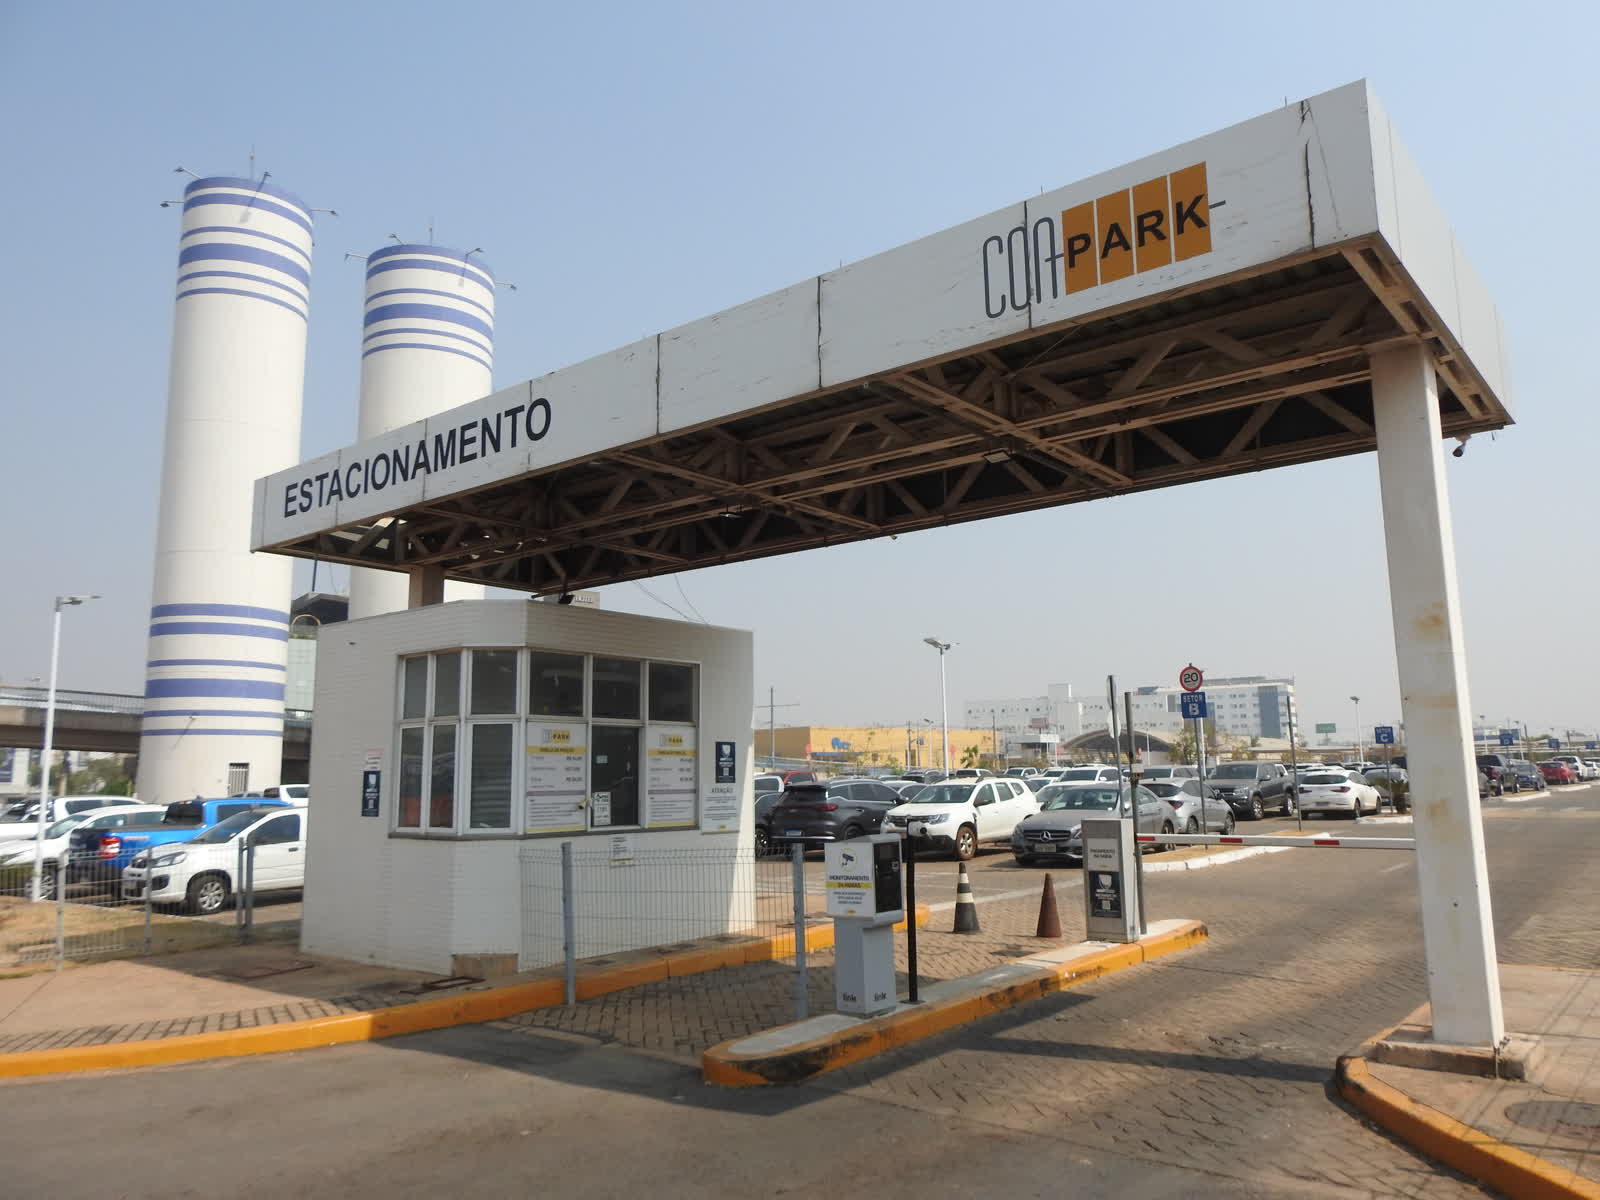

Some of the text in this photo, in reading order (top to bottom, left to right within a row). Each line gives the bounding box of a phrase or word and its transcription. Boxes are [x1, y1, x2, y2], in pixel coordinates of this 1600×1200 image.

[1067, 193, 1208, 269] PARK
[284, 397, 552, 518] ESTACIONAMENTO
[1183, 672, 1199, 683] 20
[1183, 694, 1203, 703] SETOR
[1189, 703, 1200, 716] B
[1380, 734, 1389, 742] C
